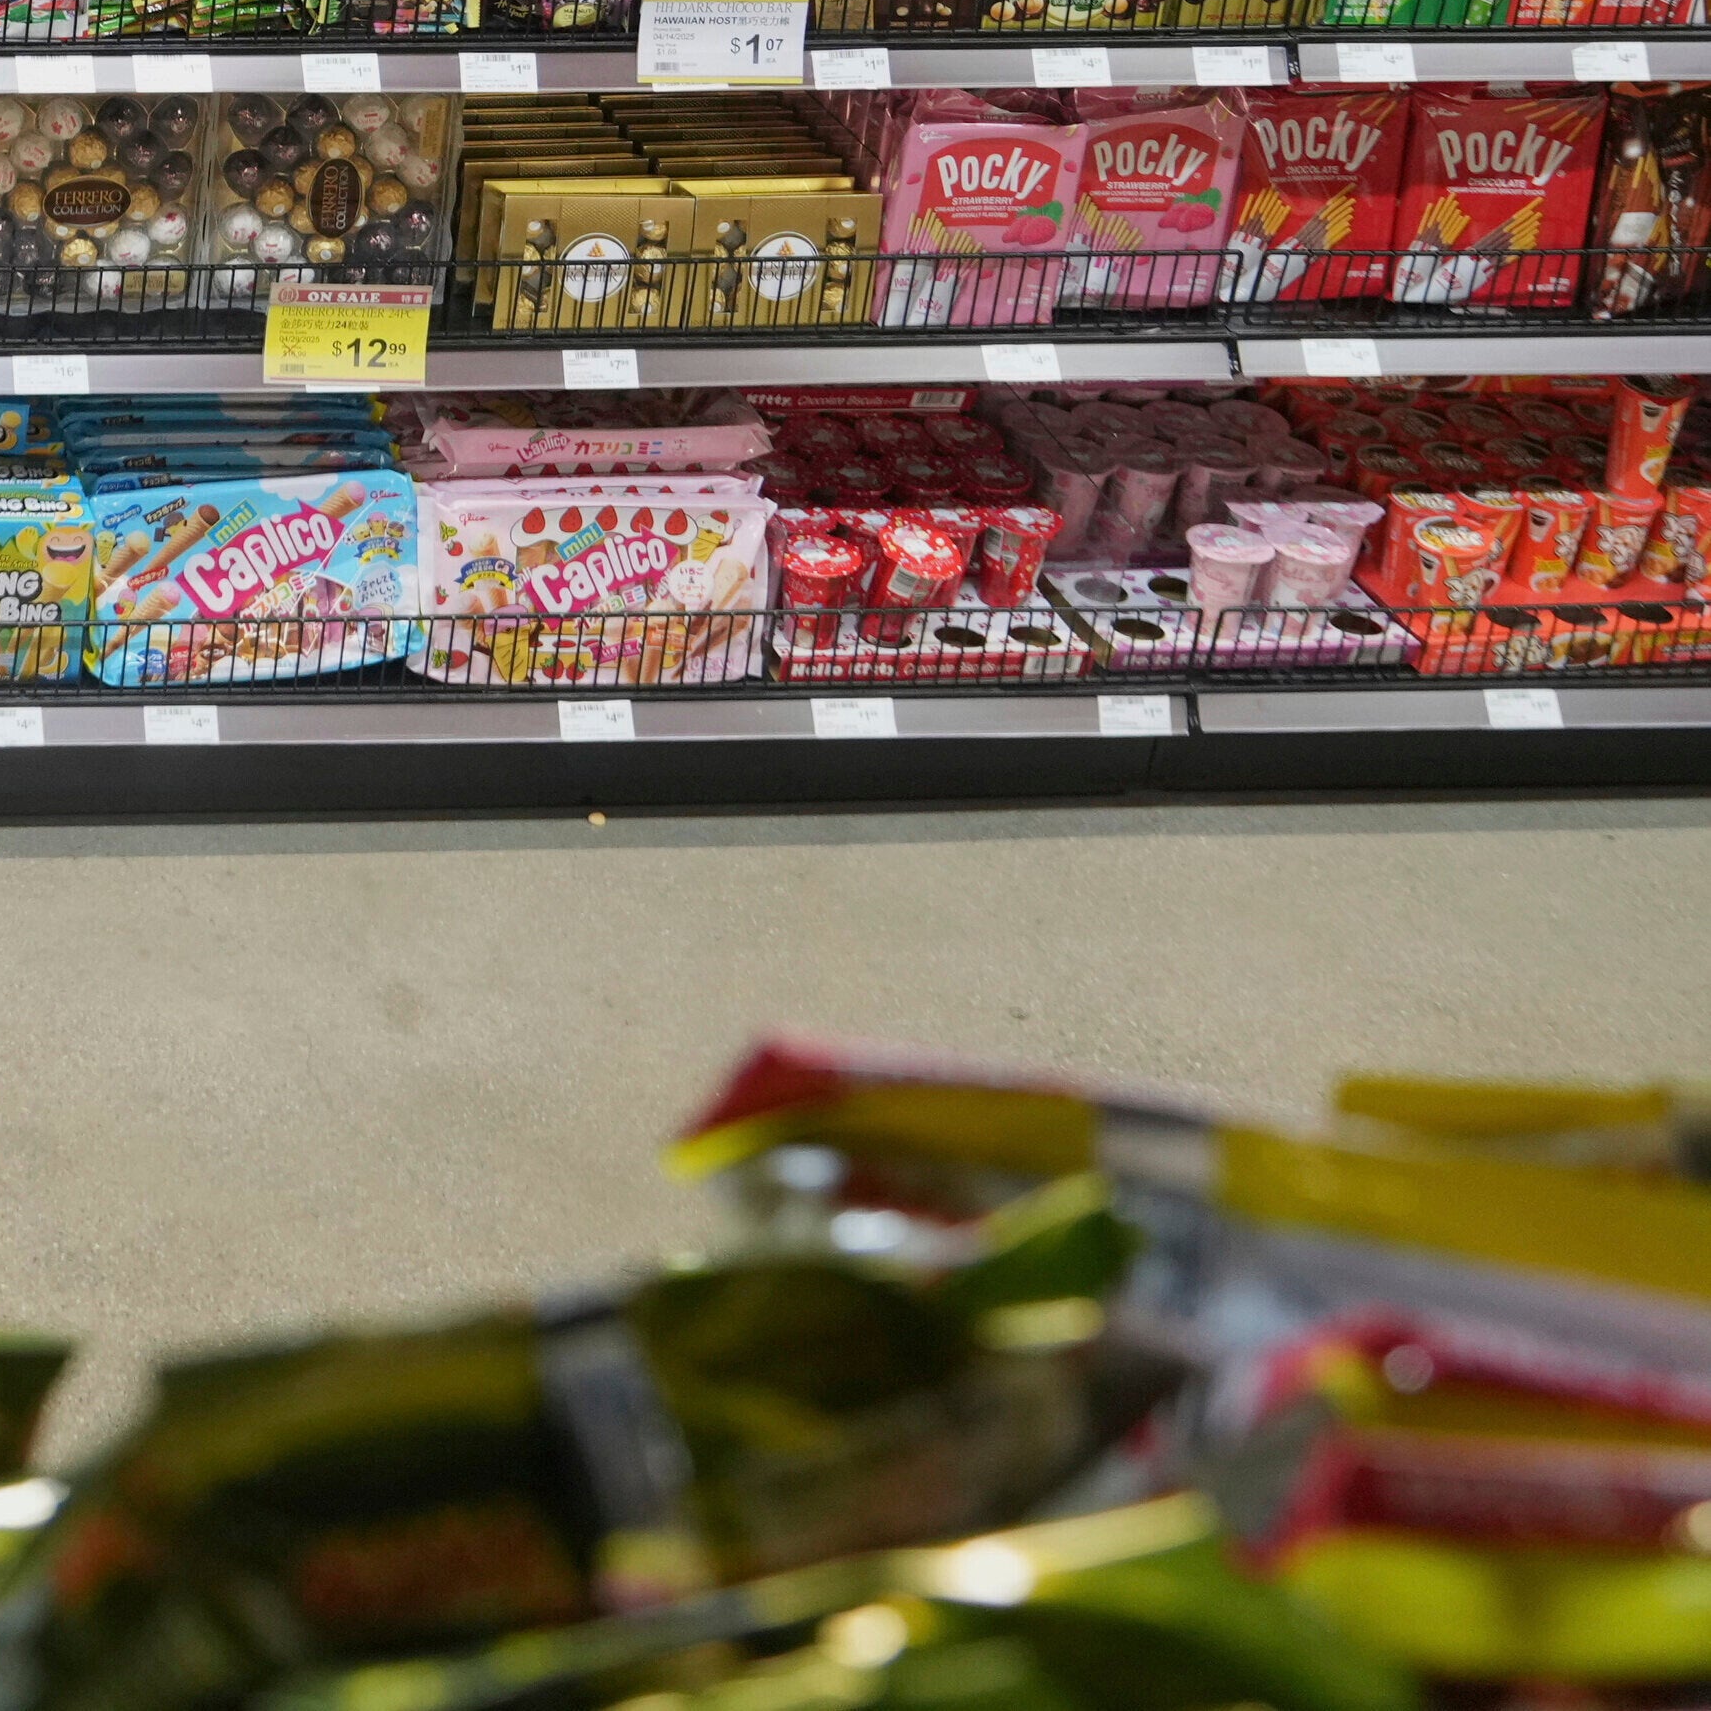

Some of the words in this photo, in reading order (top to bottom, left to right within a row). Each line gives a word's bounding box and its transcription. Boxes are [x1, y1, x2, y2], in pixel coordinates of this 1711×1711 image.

[653, 15, 705, 26] HAWAIIAN
[1468, 178, 1527, 189] CHOCOLATE
[54, 189, 124, 208] FERRERO
[951, 196, 1014, 206] STRAWBERRY
[52, 203, 122, 216] COLLECTION
[307, 291, 334, 304] ON
[336, 291, 382, 304] SALE
[218, 503, 255, 542] mini
[562, 525, 601, 557] mini
[183, 509, 335, 613] Caplico
[532, 536, 669, 616] Caplico
